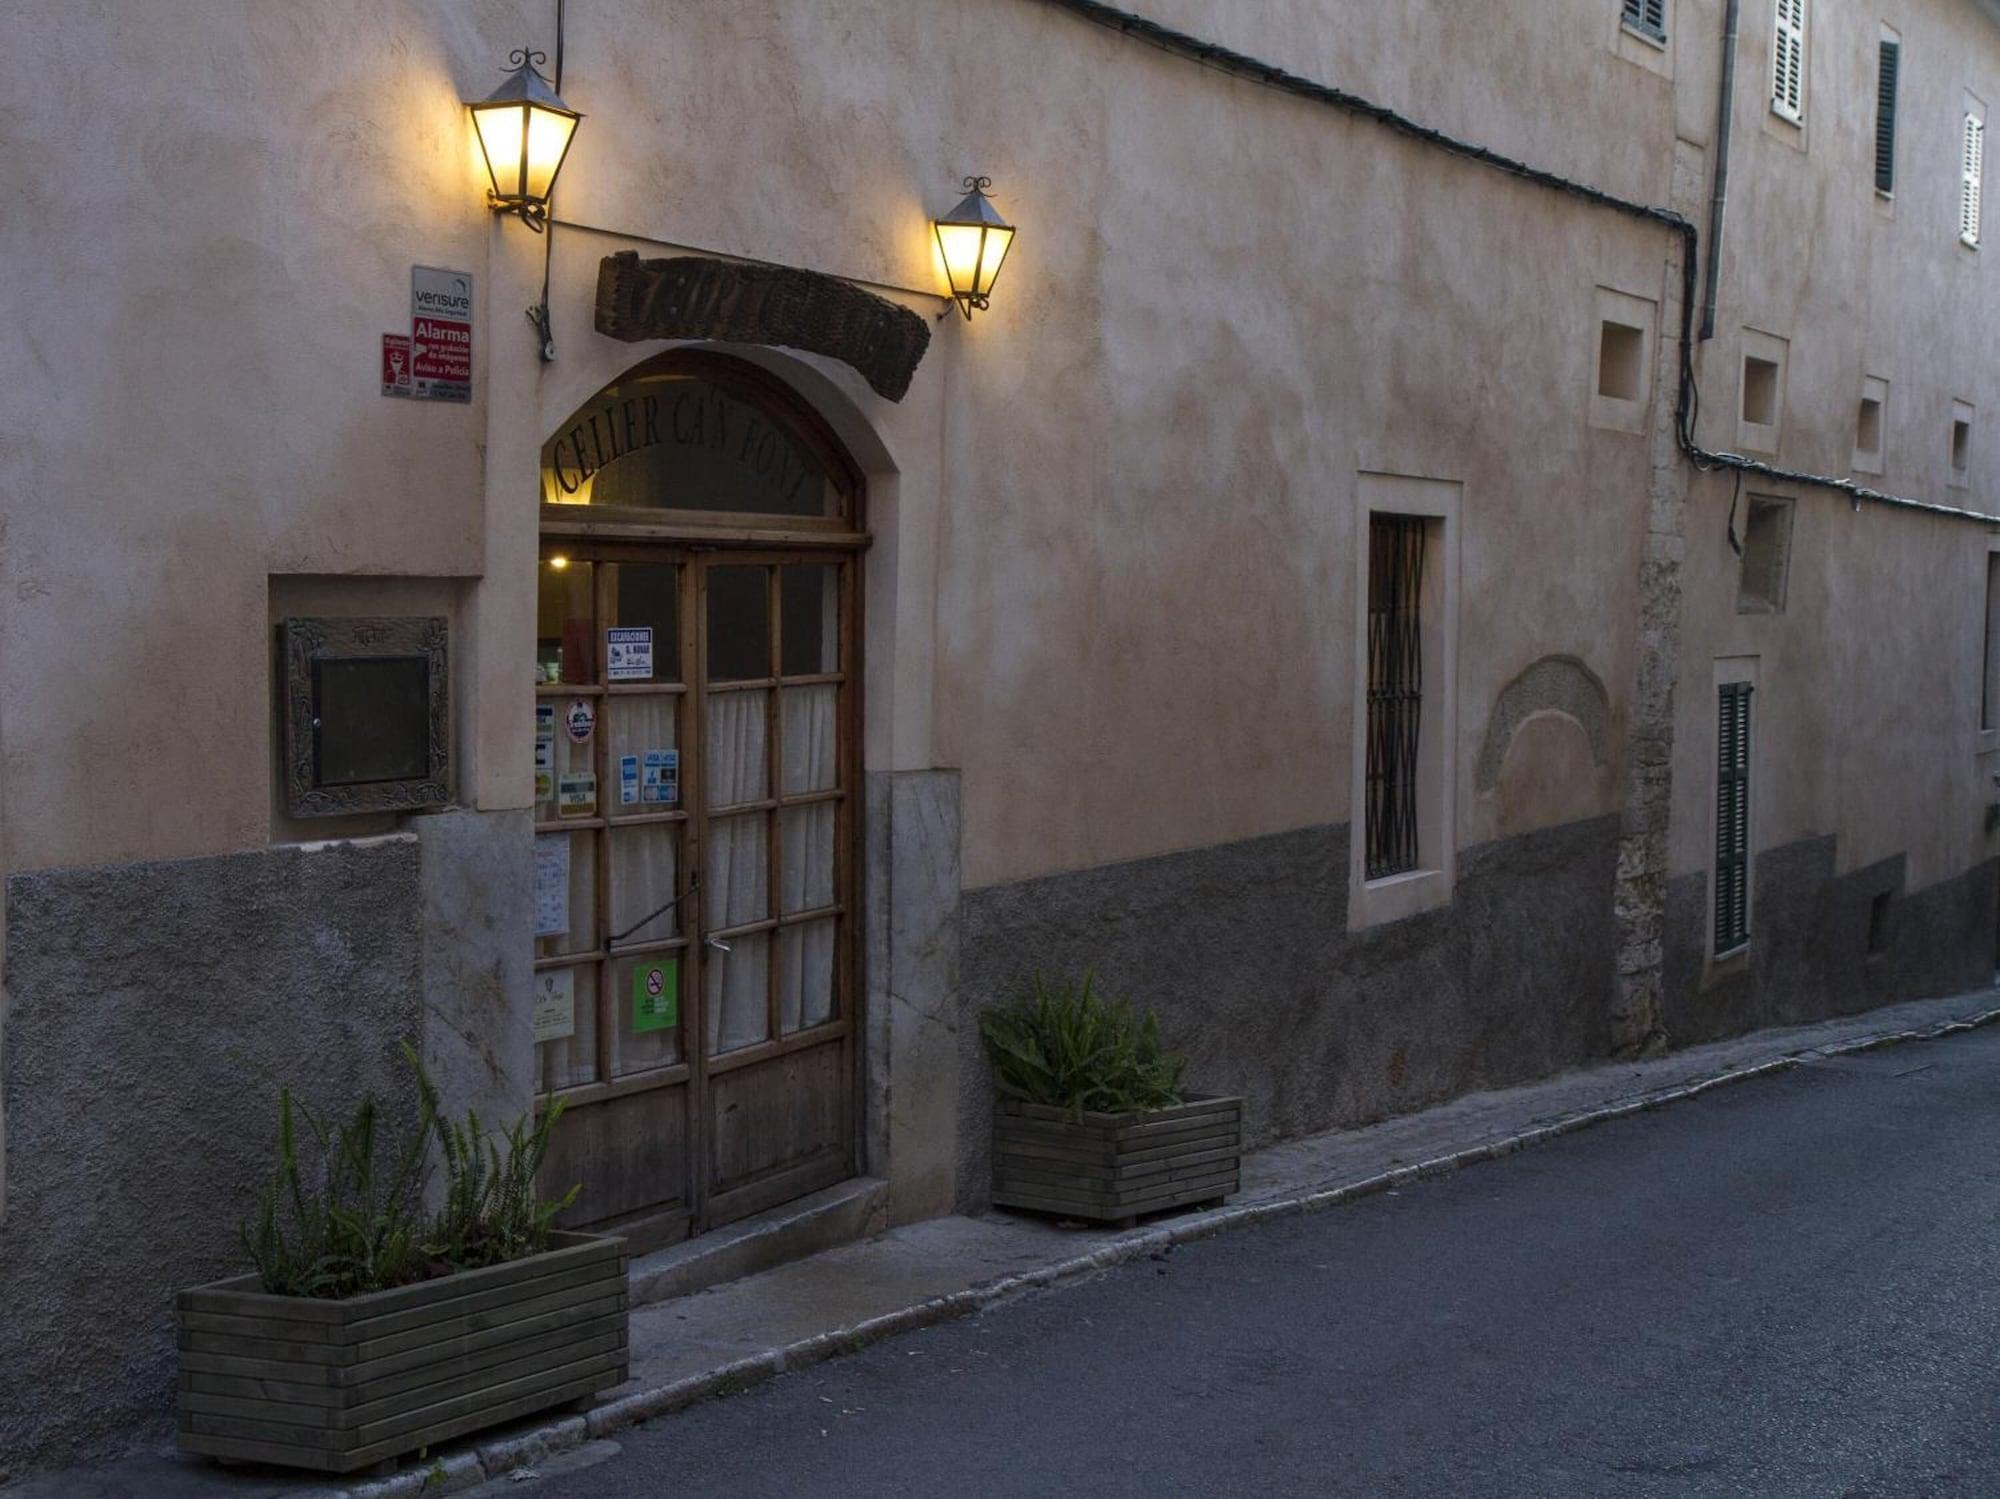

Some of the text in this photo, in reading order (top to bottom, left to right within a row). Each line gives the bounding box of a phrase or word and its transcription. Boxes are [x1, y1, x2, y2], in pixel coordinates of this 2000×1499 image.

[416, 291, 469, 309] verisure
[416, 321, 469, 343] Alarma
[416, 362, 437, 373] Aviso
[554, 394, 661, 494] CELLER
